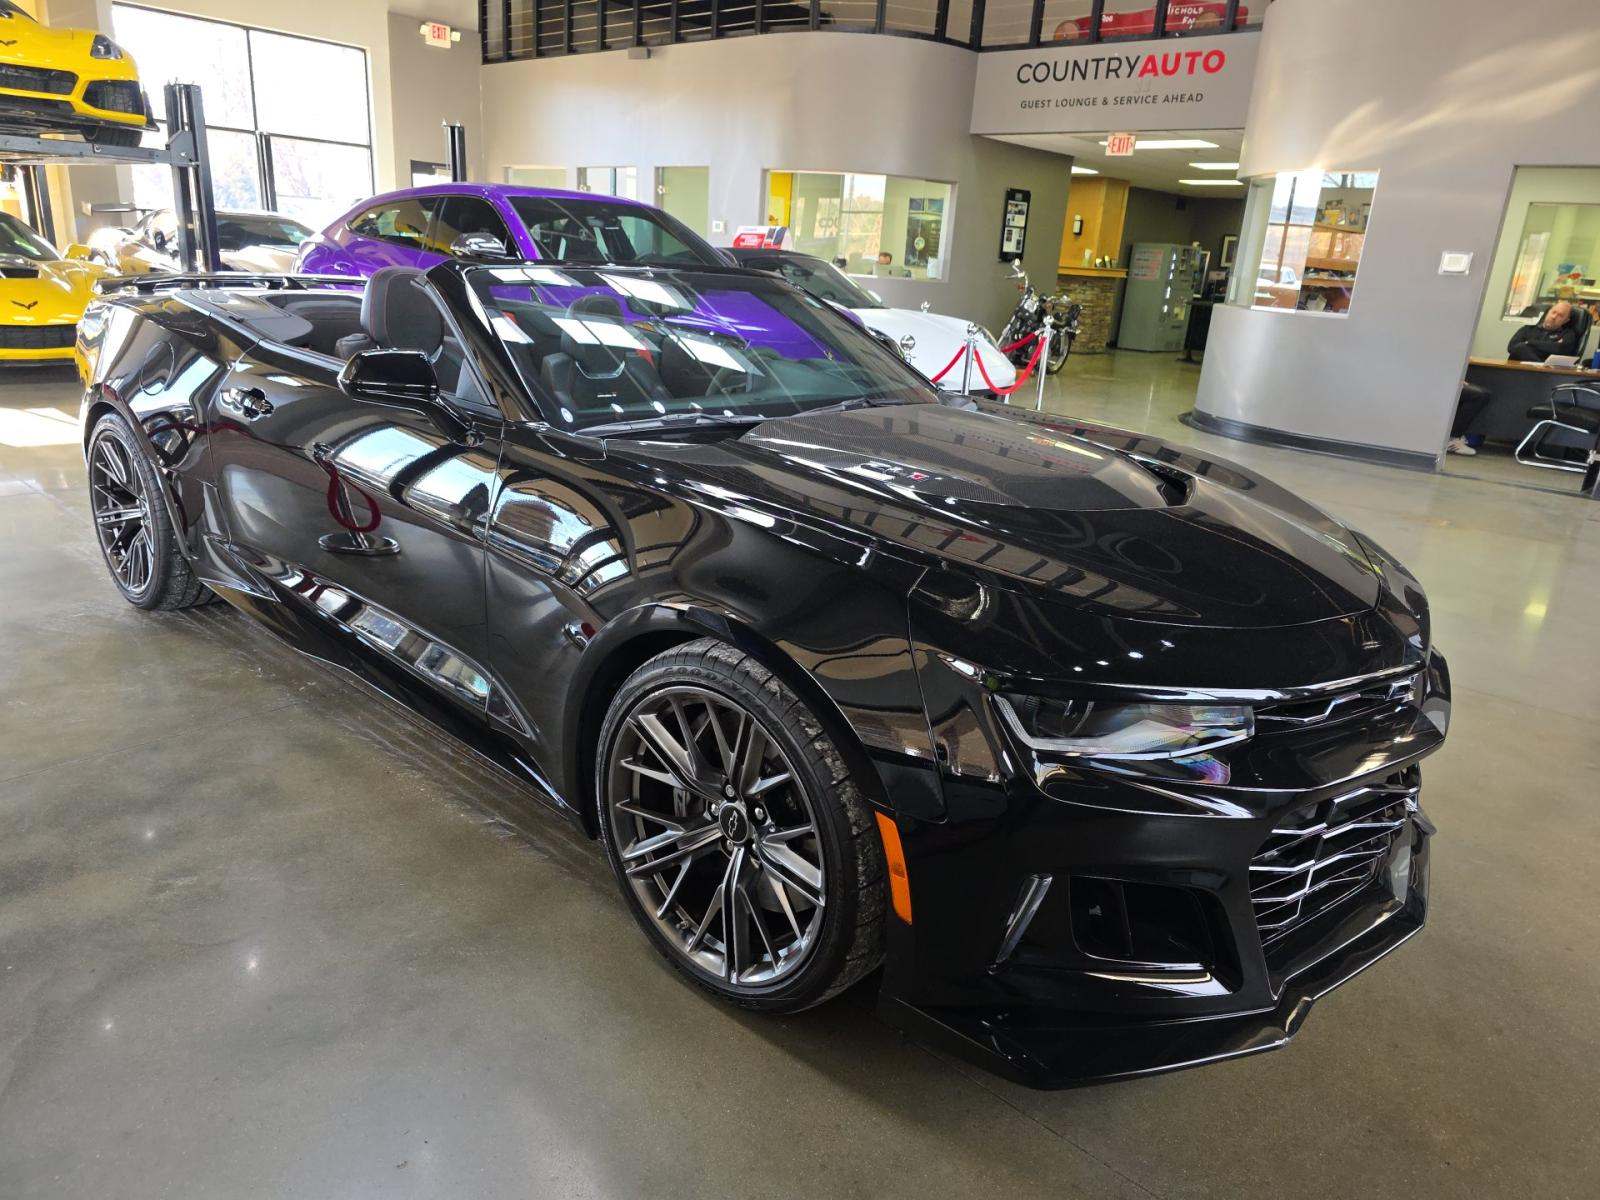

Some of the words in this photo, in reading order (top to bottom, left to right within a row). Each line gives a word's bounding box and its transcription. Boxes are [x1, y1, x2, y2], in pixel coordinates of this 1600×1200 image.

[1020, 99, 1051, 109] GUEST
[1055, 97, 1097, 107] LOUNGE
[1102, 96, 1108, 106] &
[1113, 95, 1158, 106] SERVICE
[1162, 92, 1204, 104] AHEAD
